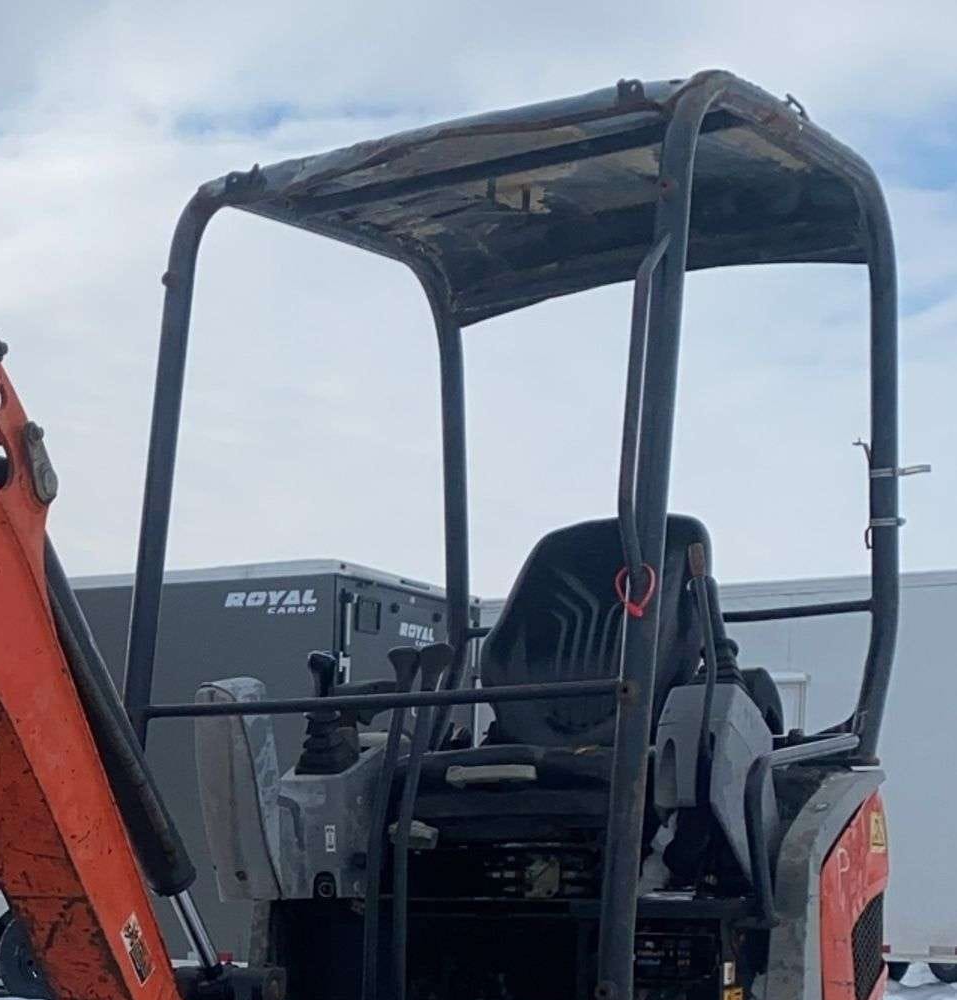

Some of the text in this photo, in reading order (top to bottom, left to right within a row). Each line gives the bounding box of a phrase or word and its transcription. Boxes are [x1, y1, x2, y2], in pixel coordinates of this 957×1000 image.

[224, 589, 318, 607] ROYAL
[266, 606, 316, 615] CARGO
[399, 622, 435, 643] ROYAL
